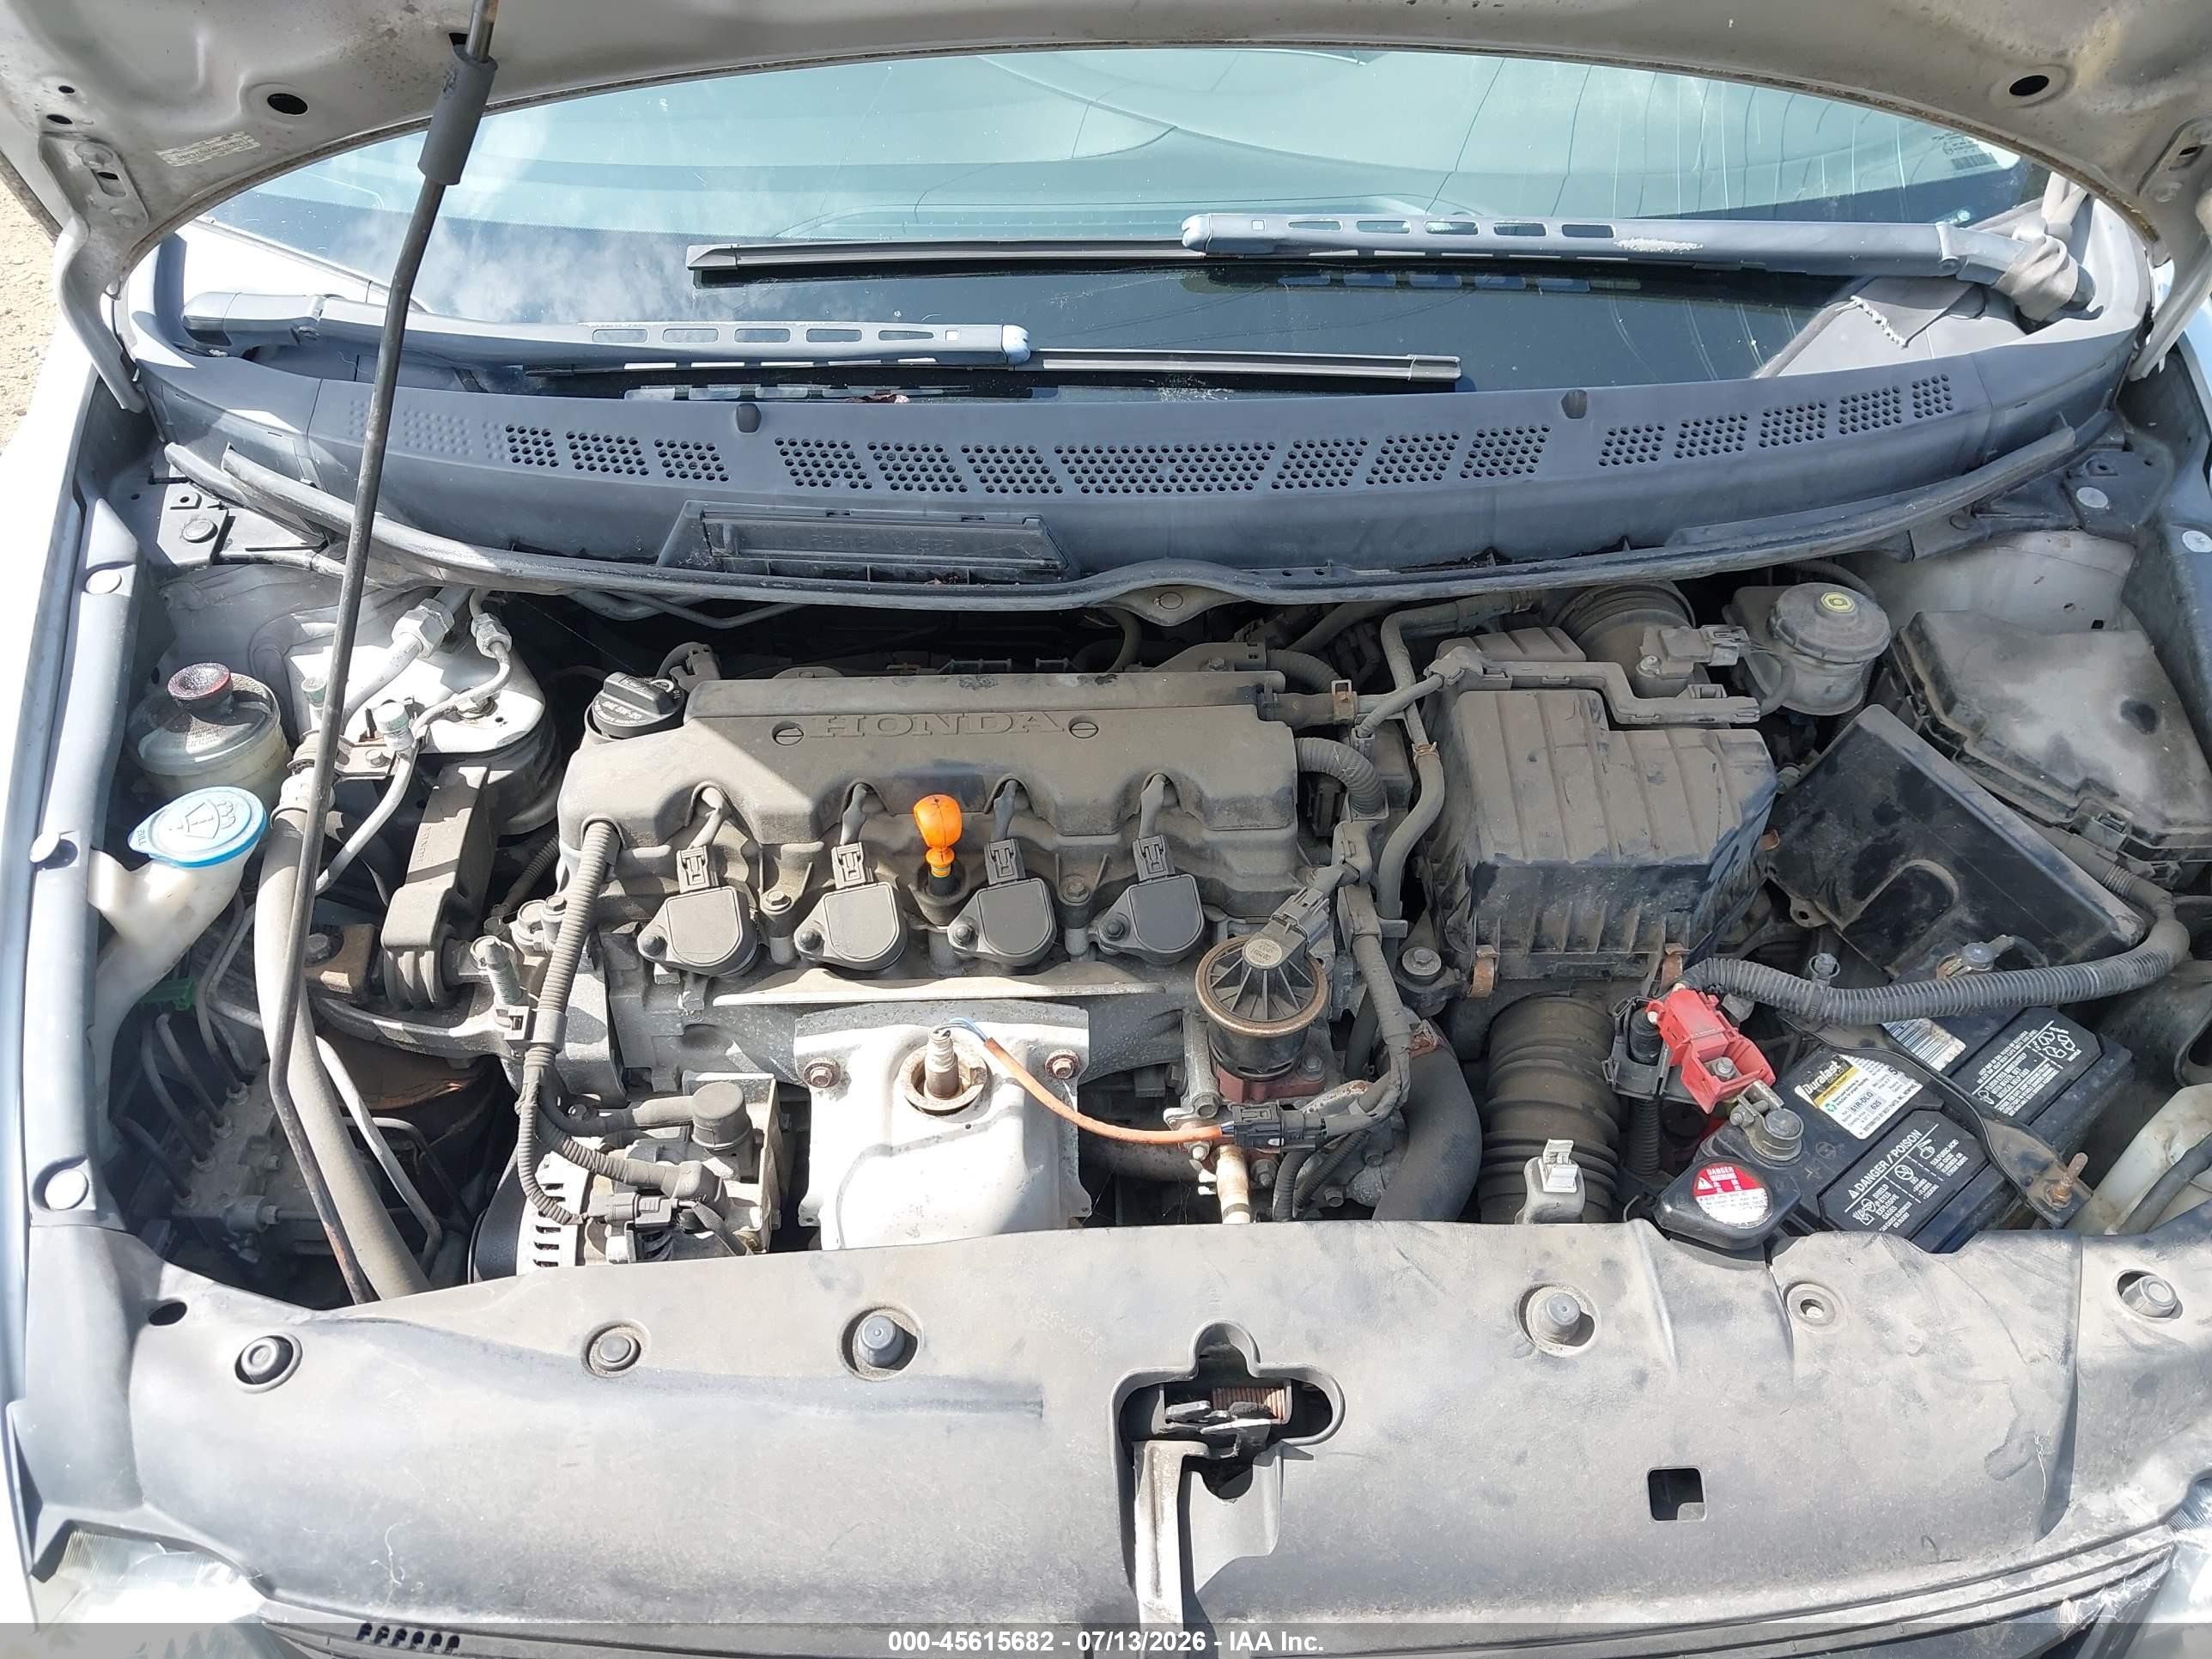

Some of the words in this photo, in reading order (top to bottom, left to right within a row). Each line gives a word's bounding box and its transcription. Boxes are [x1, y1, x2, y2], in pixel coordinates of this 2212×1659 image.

[811, 711, 1065, 737] HONDA
[1800, 1060, 1841, 1095] Duralast
[1870, 1100, 1881, 1109] 625
[1854, 1160, 1890, 1192] DANGER
[1890, 1129, 1923, 1158] POISON
[1878, 1191, 1891, 1203] EYES
[1880, 1206, 1898, 1219] GASES
